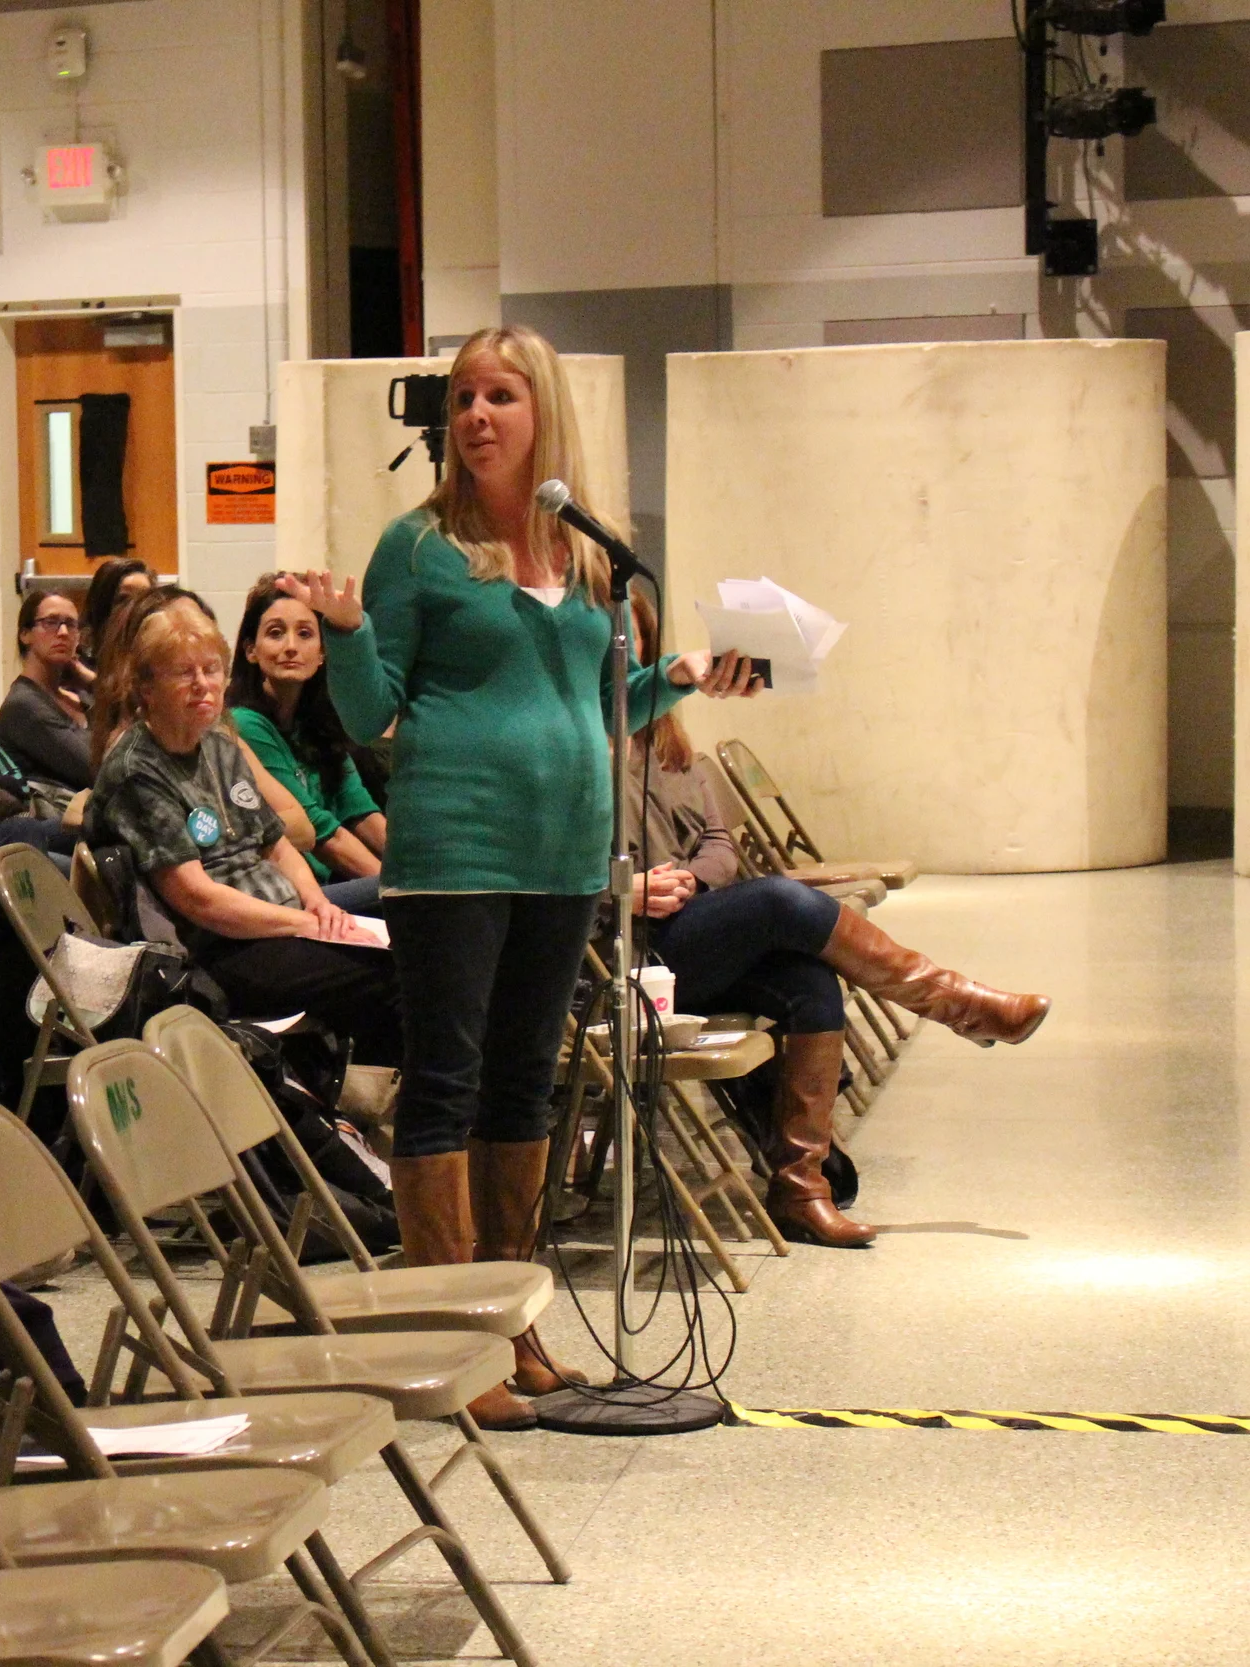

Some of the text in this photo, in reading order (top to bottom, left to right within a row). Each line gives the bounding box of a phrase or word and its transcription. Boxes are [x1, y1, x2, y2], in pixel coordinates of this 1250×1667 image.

[214, 474, 271, 484] WARNING
[197, 811, 218, 829] FULL
[195, 821, 214, 836] DAY
[197, 833, 207, 842] K
